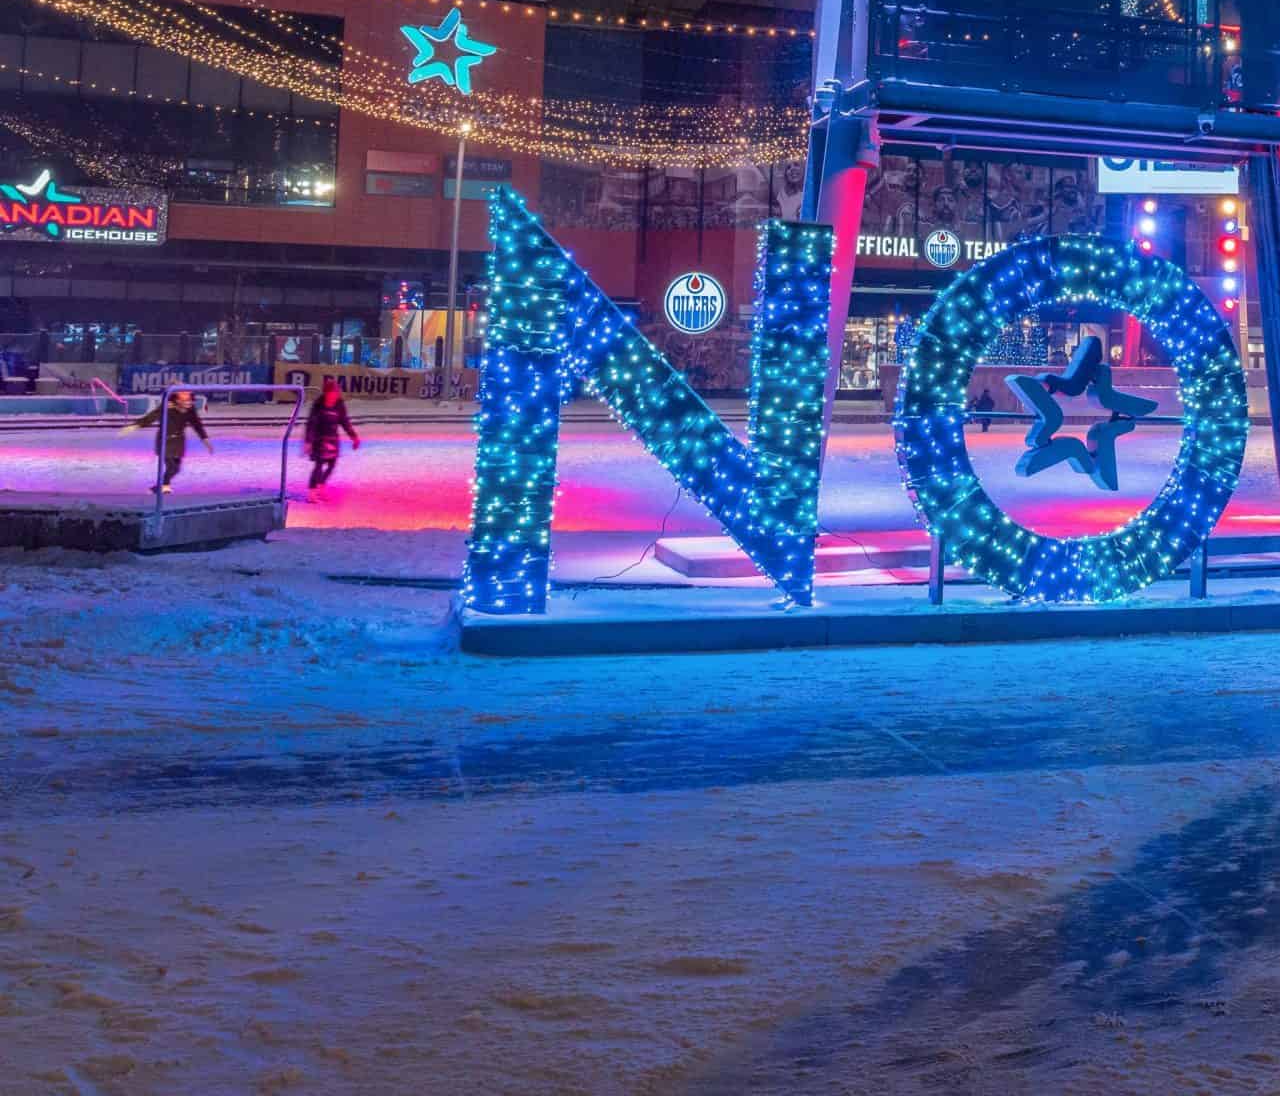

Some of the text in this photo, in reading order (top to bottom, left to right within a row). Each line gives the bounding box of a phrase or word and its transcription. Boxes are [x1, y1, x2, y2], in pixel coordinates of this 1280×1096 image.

[66, 228, 158, 242] ICEHOUSE
[855, 235, 919, 258] FFICIAL
[673, 295, 718, 329] OILERS
